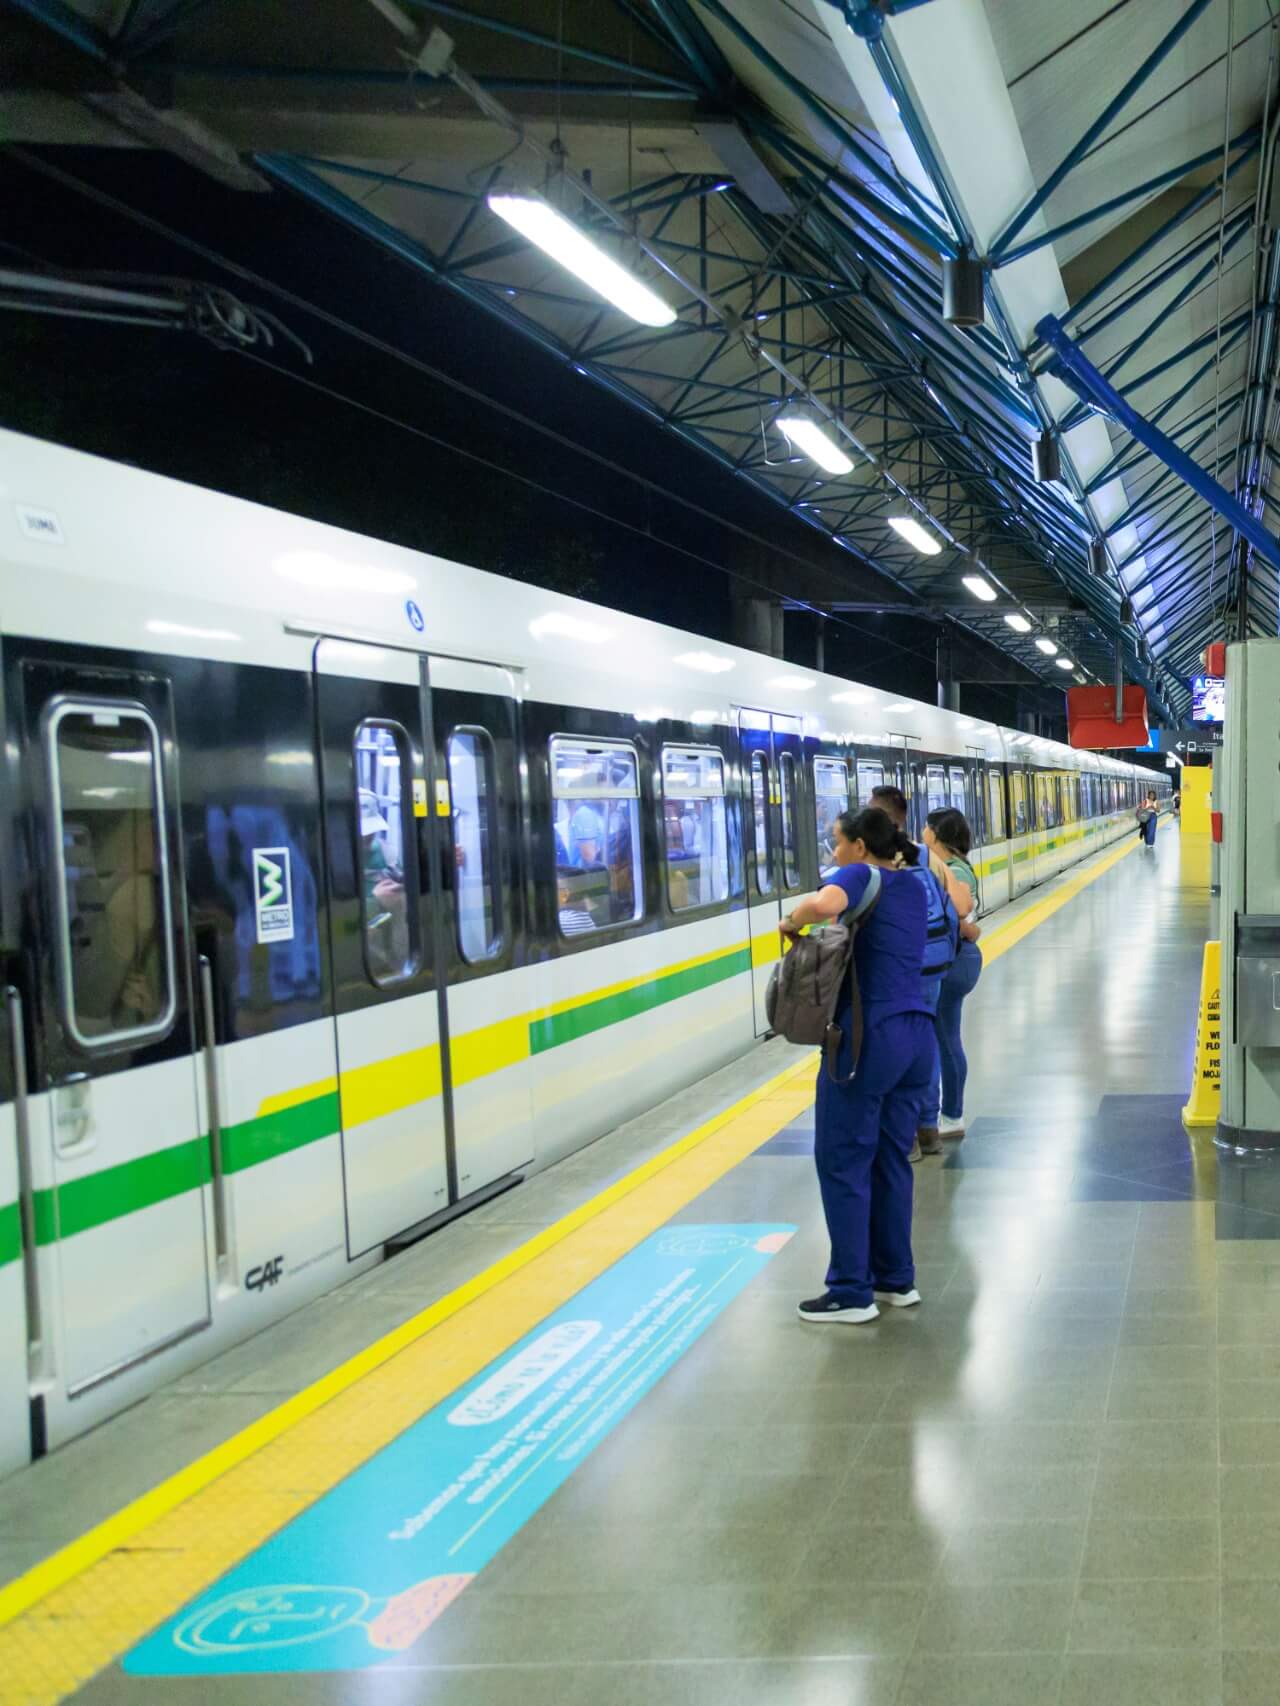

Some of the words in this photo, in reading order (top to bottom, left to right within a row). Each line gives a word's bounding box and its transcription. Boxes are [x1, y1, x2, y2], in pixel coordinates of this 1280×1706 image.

[261, 910, 289, 922] METRO
[1206, 1042, 1220, 1050] FLO
[244, 1255, 284, 1292] CAF
